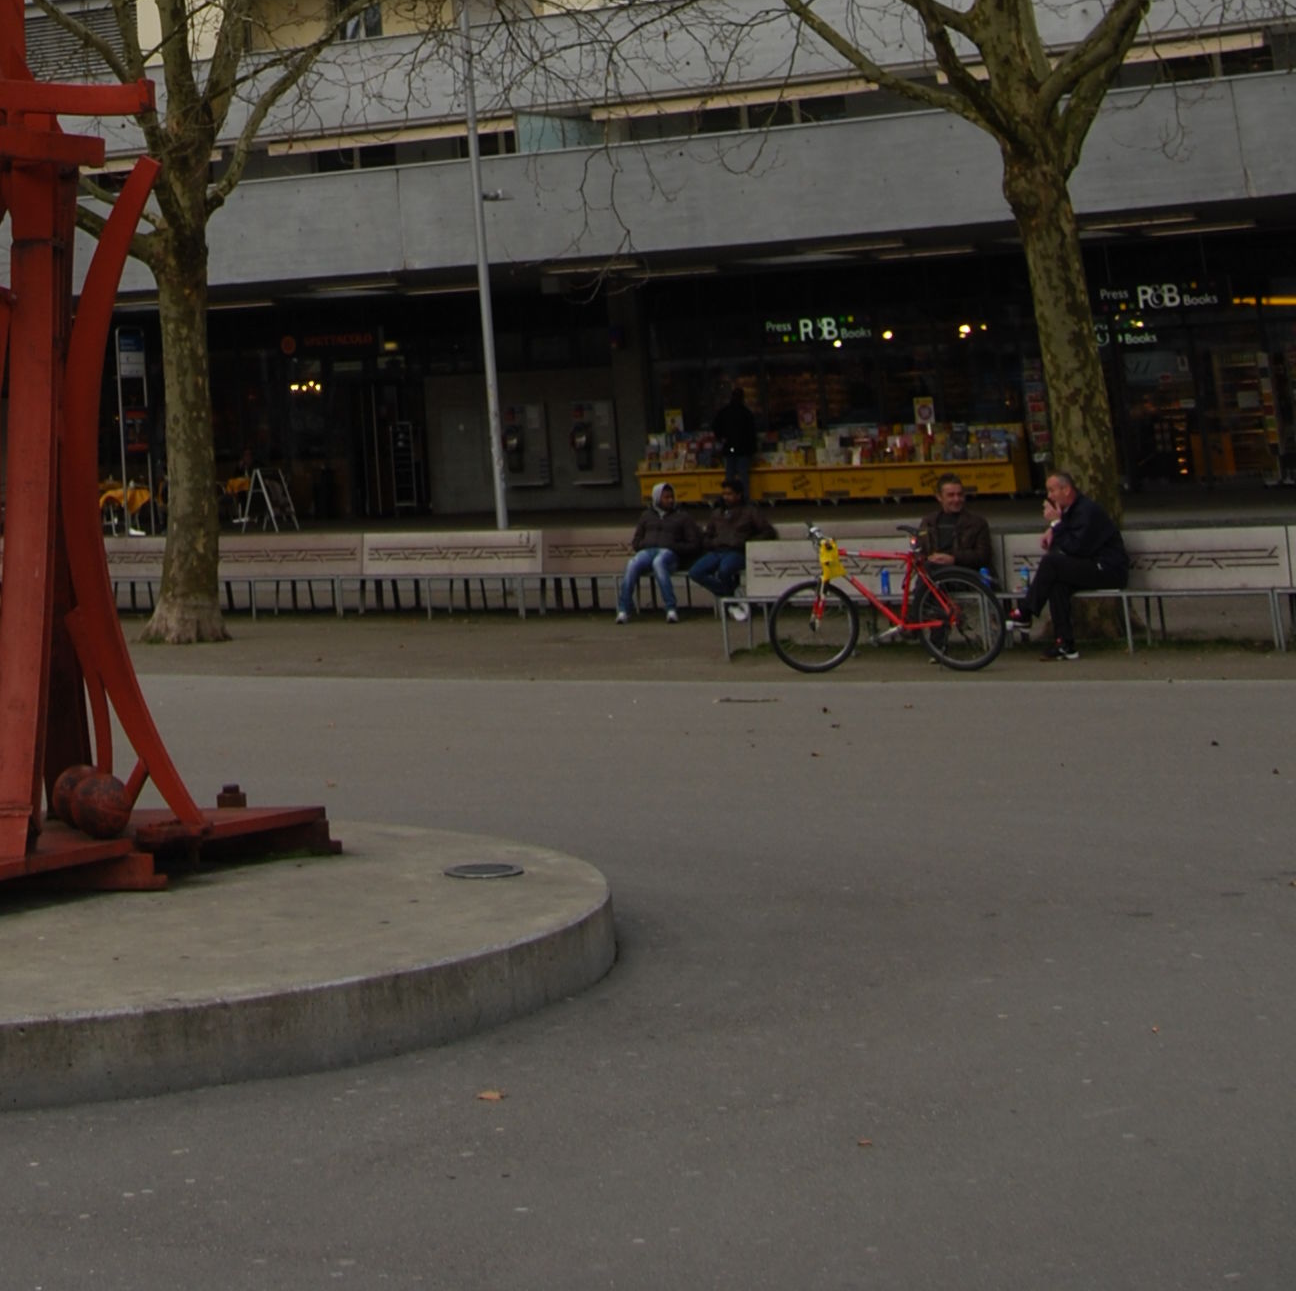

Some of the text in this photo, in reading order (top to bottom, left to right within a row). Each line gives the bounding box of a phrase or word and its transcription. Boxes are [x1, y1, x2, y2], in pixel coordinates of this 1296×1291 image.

[1099, 288, 1129, 300] Press
[1183, 293, 1219, 306] Books
[765, 321, 792, 332] Press
[840, 327, 872, 339] Books
